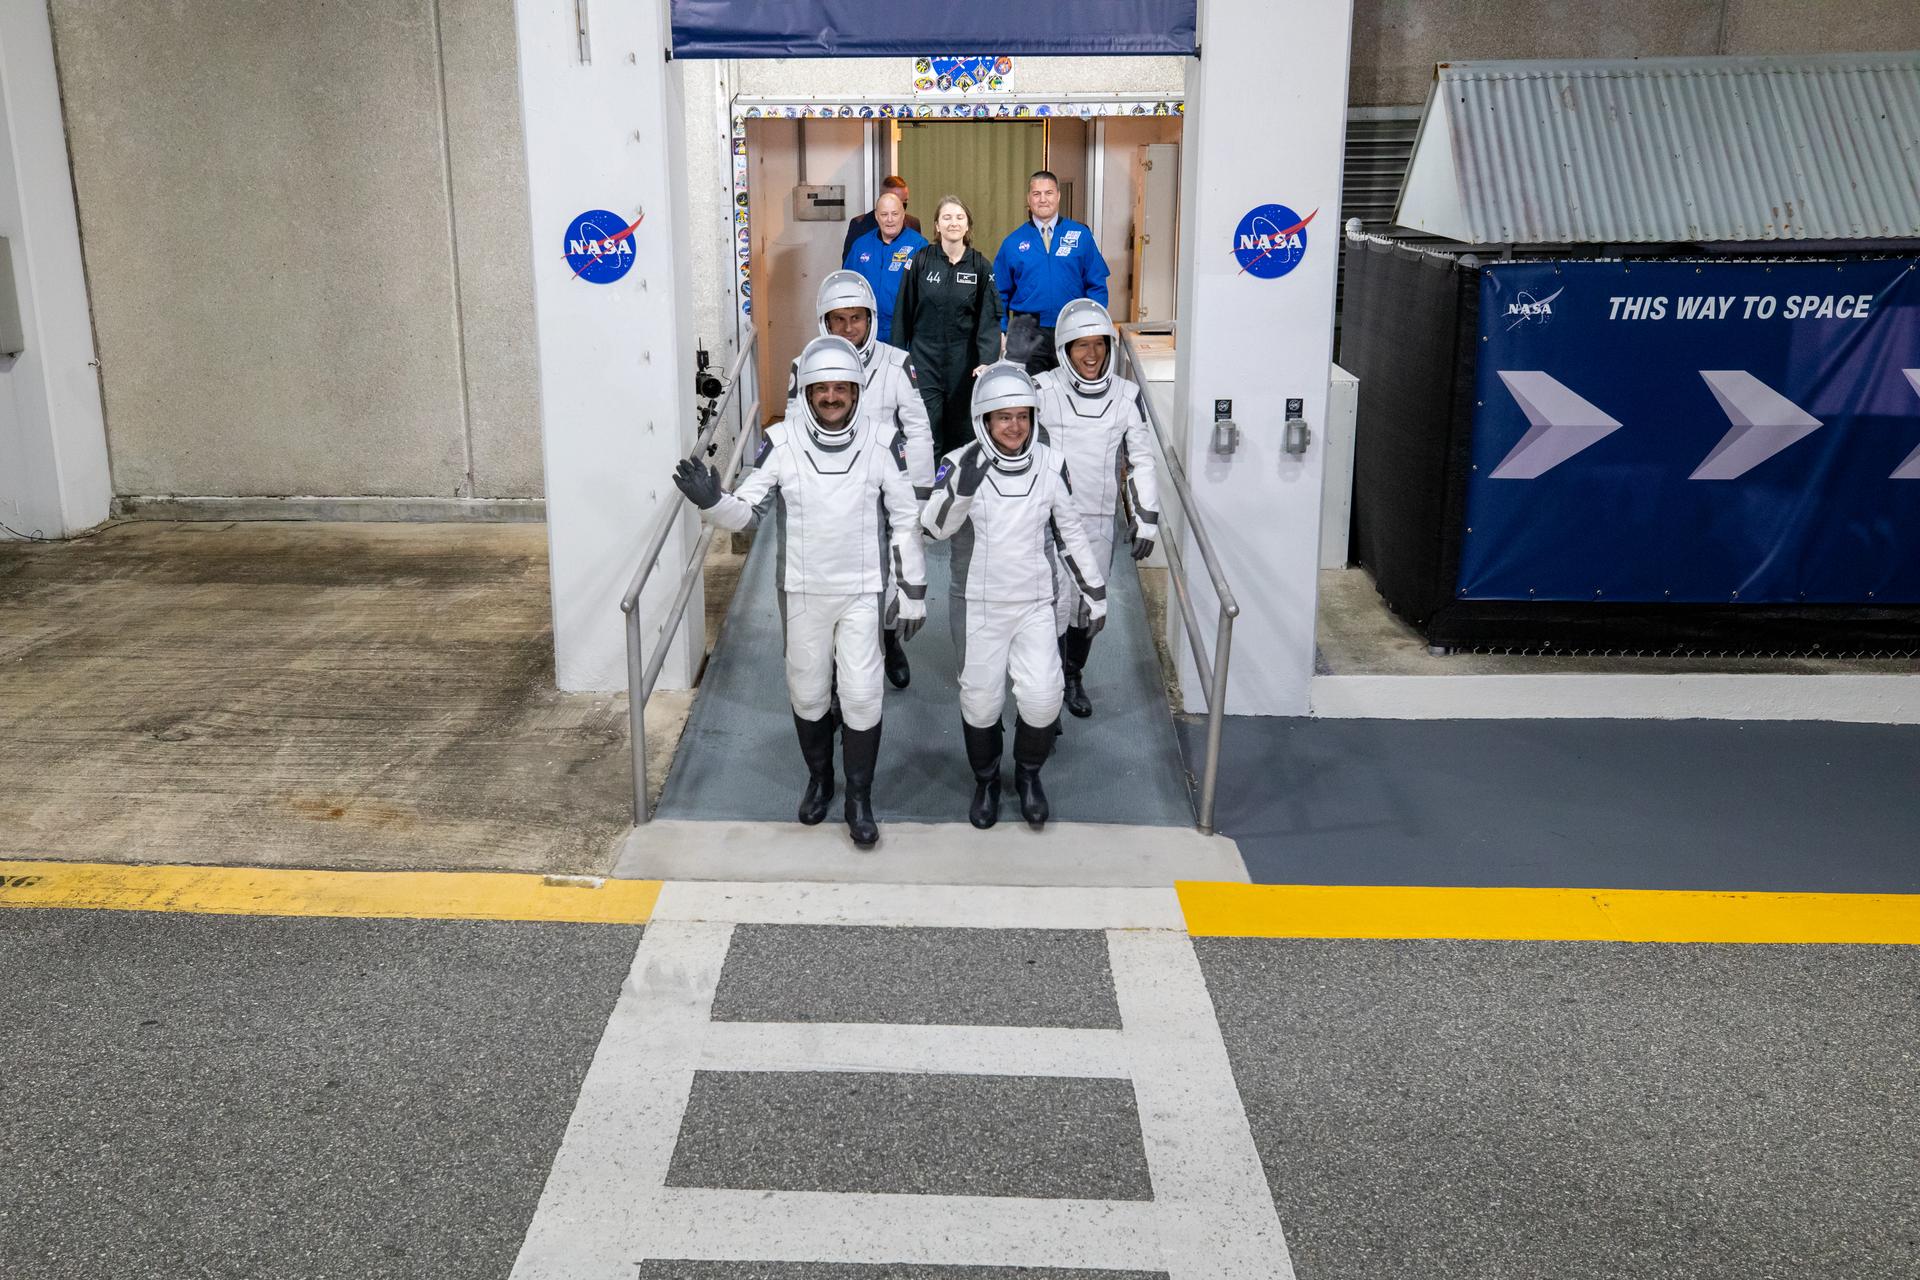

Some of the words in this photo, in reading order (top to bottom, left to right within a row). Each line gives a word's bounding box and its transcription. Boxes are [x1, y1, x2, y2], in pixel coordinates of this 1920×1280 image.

[569, 239, 633, 255] NASA
[1240, 234, 1303, 250] NASA
[926, 271, 941, 284] 44
[1508, 303, 1552, 315] NASA
[1609, 296, 1668, 320] THIS
[1676, 296, 1736, 320] WAY
[1743, 296, 1777, 320] TO
[1783, 295, 1874, 319] SPACE
